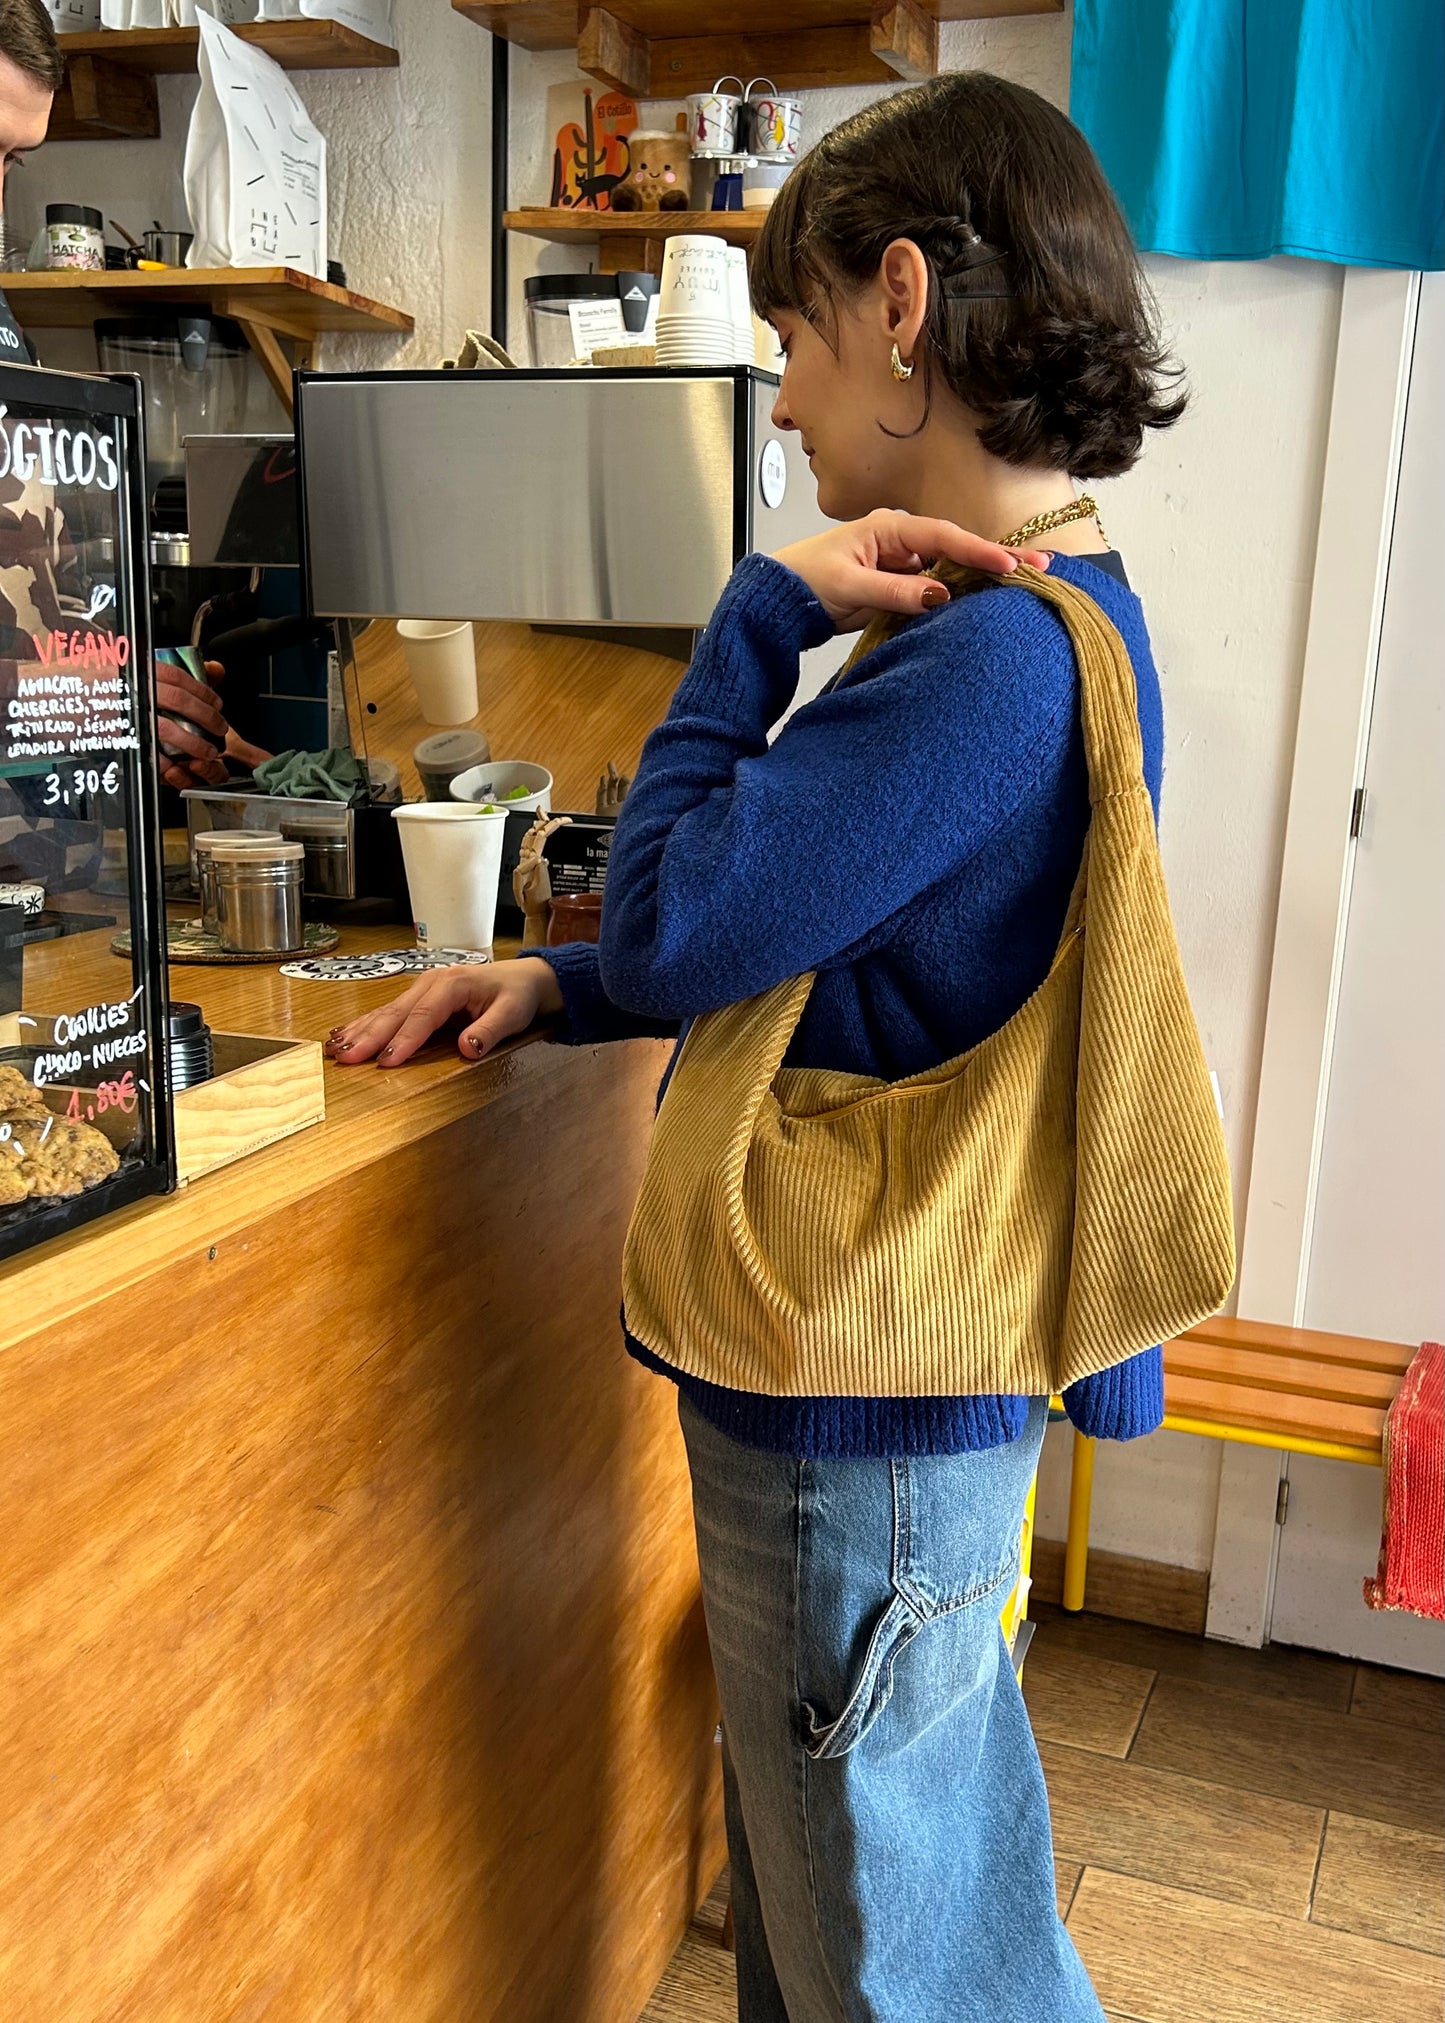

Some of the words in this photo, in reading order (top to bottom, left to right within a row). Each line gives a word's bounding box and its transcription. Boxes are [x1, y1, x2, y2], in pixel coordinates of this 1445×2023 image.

[52, 244, 100, 258] MATCHA
[0, 326, 19, 348] TO
[32, 629, 129, 670] VEGANO
[92, 678, 129, 696] AOVE,
[88, 698, 131, 711] TOMATE
[84, 714, 135, 736] SÉSAMO,
[8, 740, 65, 758] LEVADURA
[43, 761, 119, 805] 3,30€
[596, 849, 608, 858] ma
[34, 1029, 147, 1088] CHOCO-NUECES
[66, 1070, 138, 1126] 1,80€
